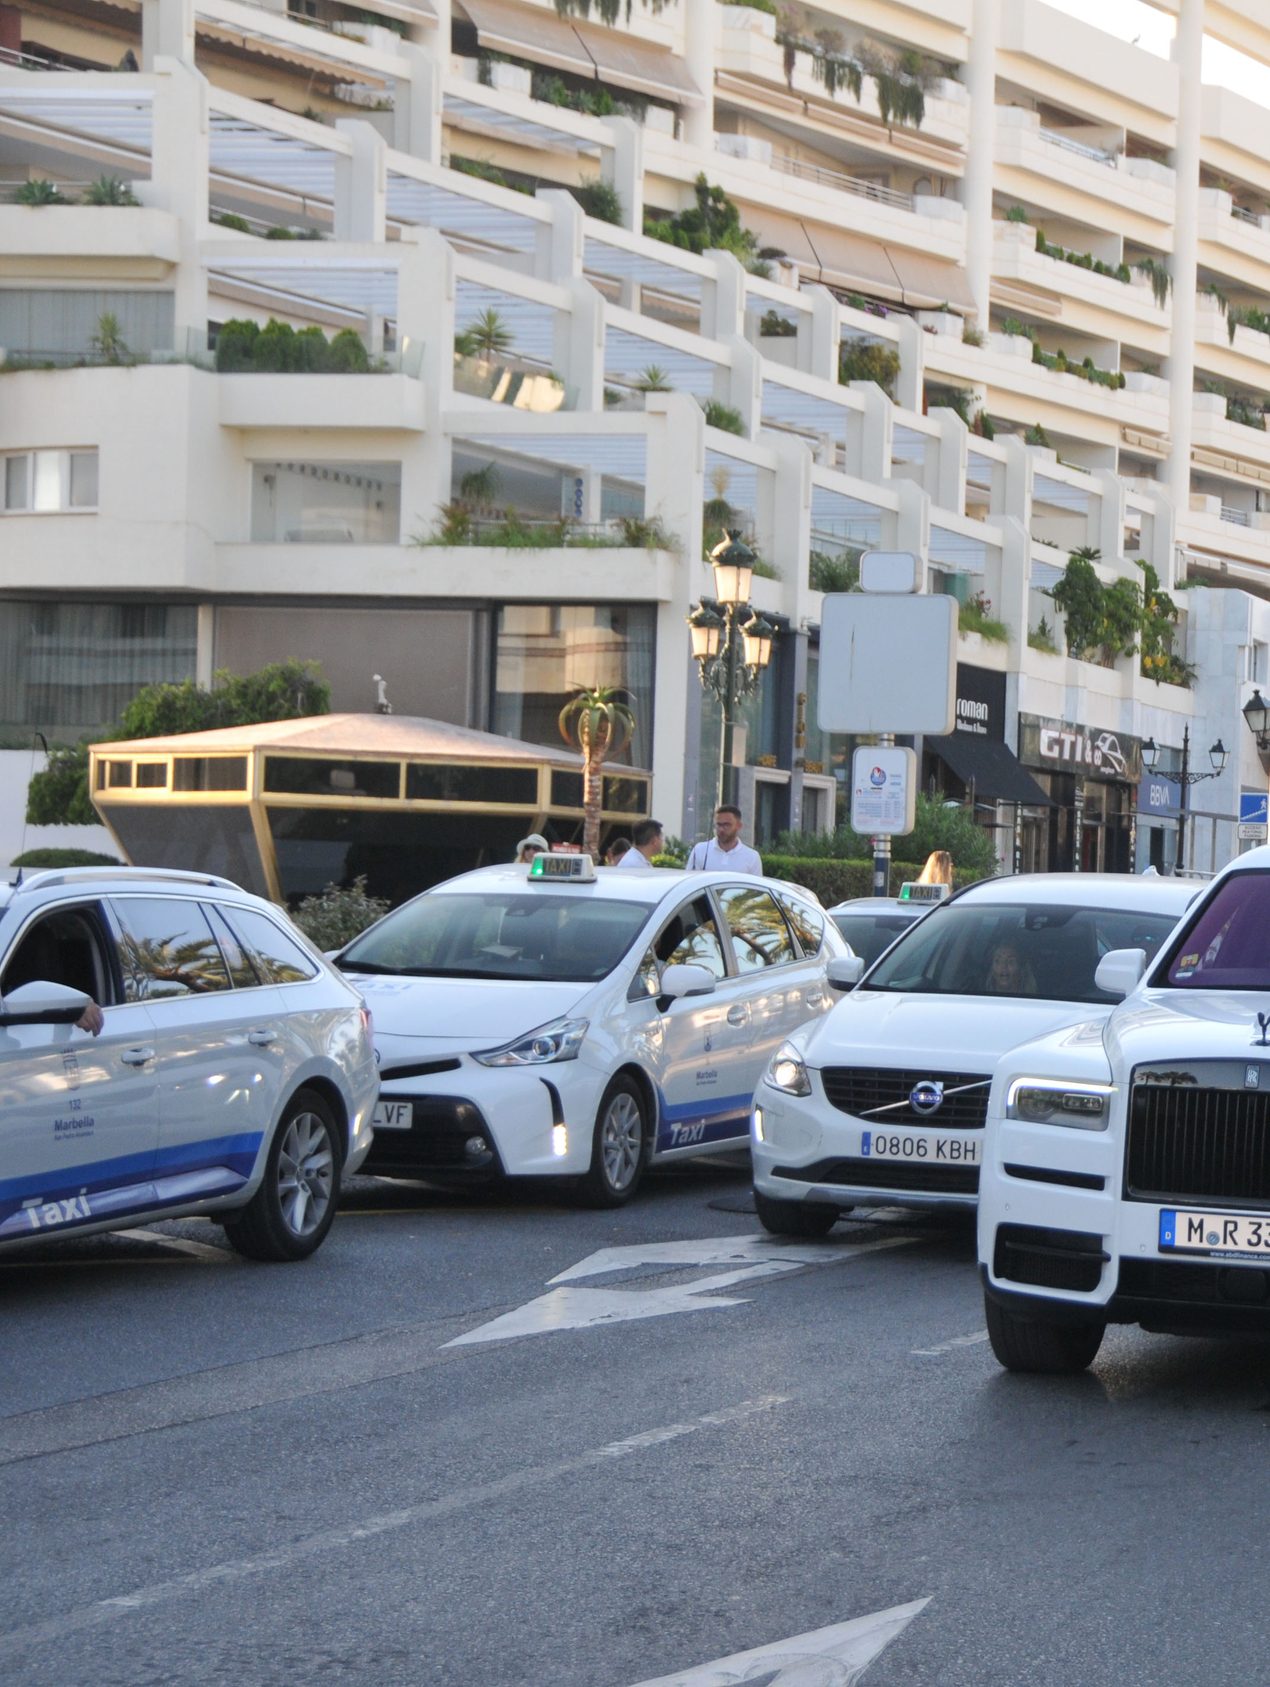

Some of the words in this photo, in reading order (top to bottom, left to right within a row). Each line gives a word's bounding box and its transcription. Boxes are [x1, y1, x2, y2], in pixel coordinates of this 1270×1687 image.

[956, 698, 988, 721] roman
[1039, 728, 1083, 762] GTI
[1150, 784, 1170, 806] BBVA
[545, 858, 570, 874] TAXI
[911, 886, 932, 899] TAXI
[69, 1098, 82, 1111] 132
[912, 1092, 941, 1102] VOLVO
[54, 1116, 95, 1132] Marbella
[670, 1118, 706, 1145] Taxi
[875, 1135, 928, 1158] 0806
[936, 1139, 976, 1161] KBH
[22, 1187, 92, 1229] Taxi
[1165, 1231, 1172, 1240] D
[1187, 1217, 1204, 1243] M
[1223, 1220, 1239, 1246] R
